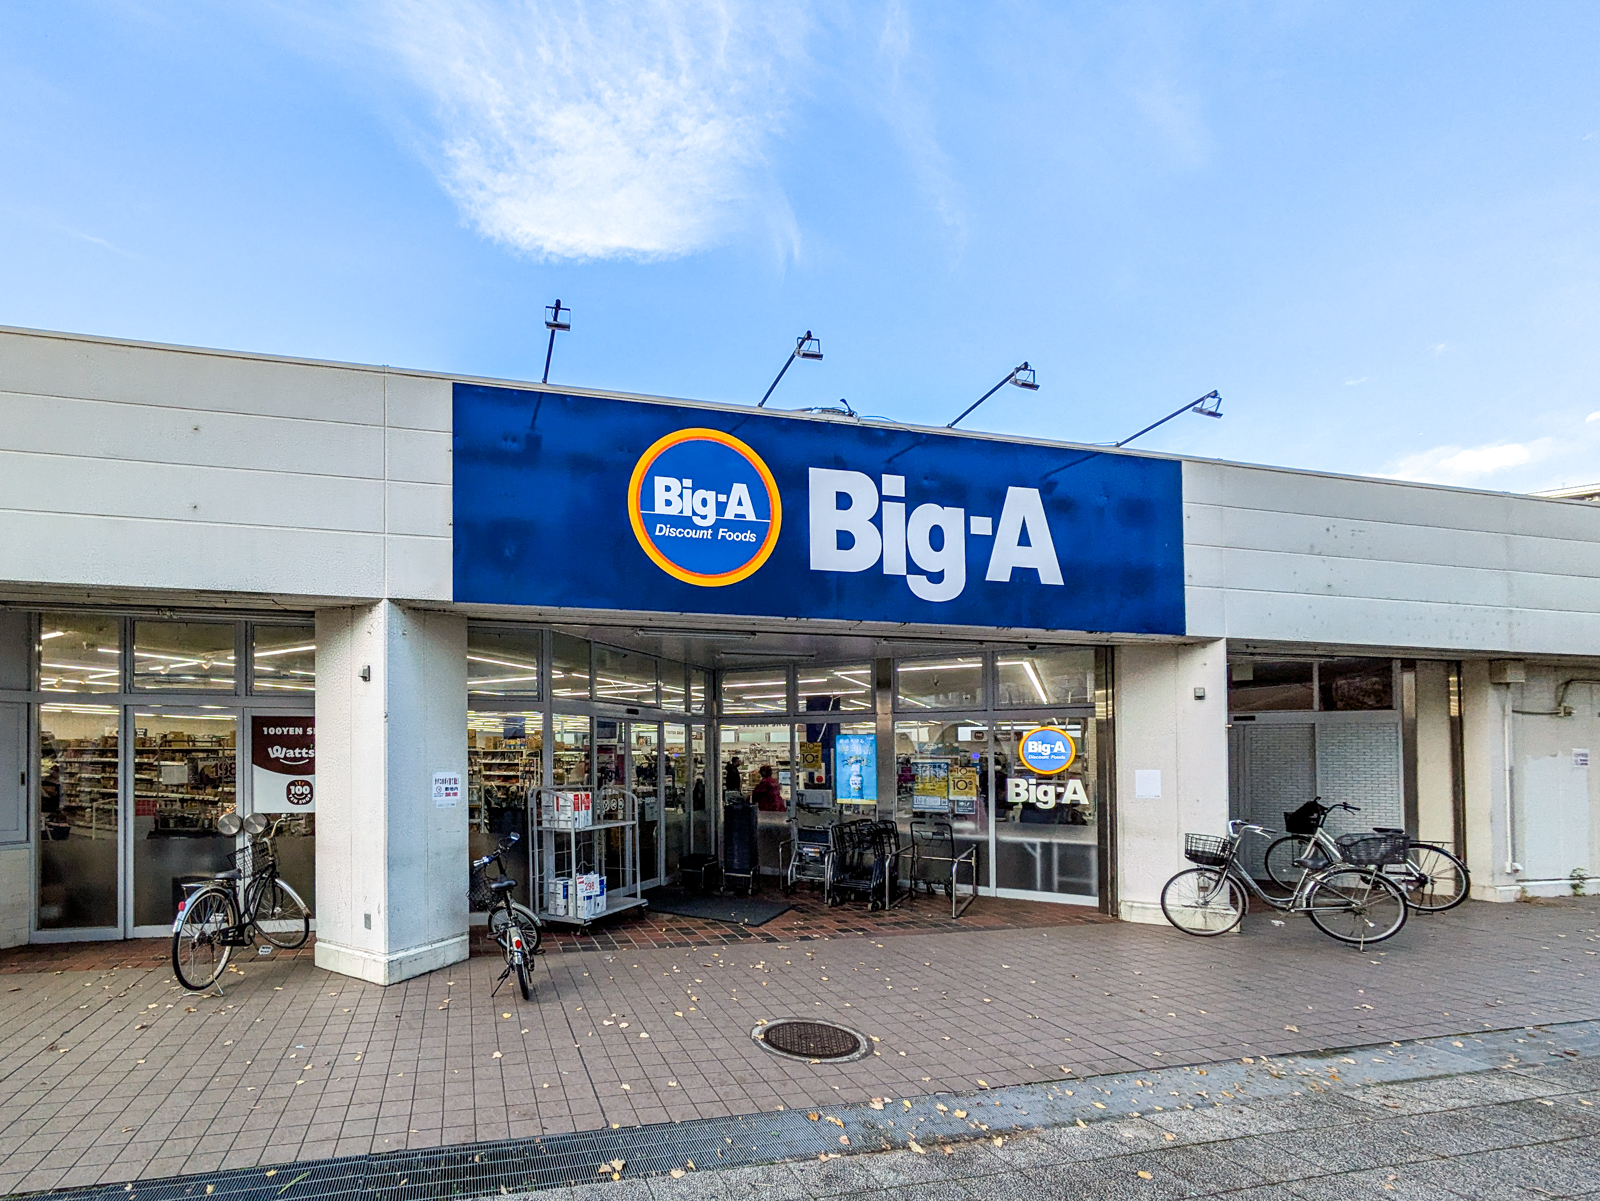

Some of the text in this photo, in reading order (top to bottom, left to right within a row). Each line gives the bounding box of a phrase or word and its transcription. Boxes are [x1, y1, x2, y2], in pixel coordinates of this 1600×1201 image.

[654, 475, 757, 527] Big-A
[655, 523, 757, 542] Discount Foods
[808, 467, 1065, 602] Big-A
[262, 726, 304, 735] 100YEN
[1027, 740, 1066, 755] Big-A
[211, 762, 236, 777] 198
[289, 785, 311, 795] 100
[1006, 778, 1090, 809] Big-A
